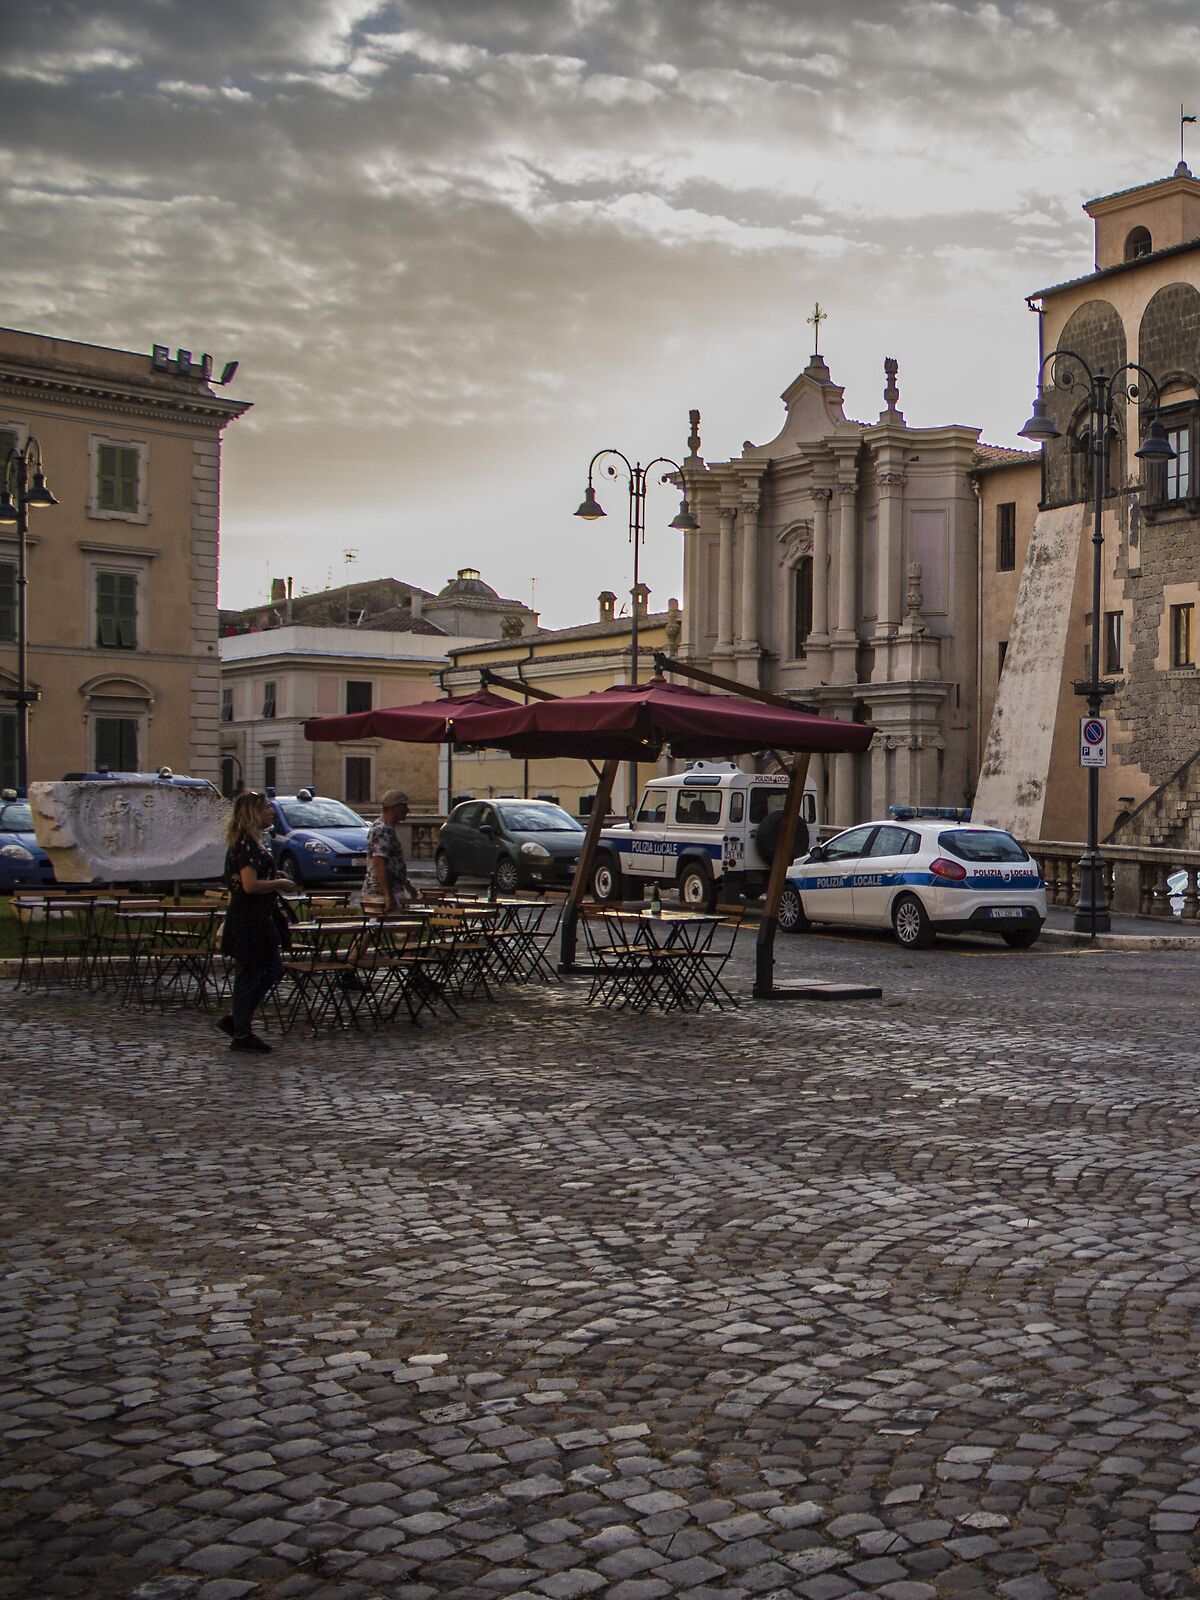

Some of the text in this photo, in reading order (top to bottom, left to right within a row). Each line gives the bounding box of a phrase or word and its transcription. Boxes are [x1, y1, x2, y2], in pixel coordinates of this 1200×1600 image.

[632, 841, 678, 855] POLIZIA LOCALE
[973, 869, 1034, 877] POLIZIA LOCALE
[816, 875, 882, 888] POLIZIA LOCALE
